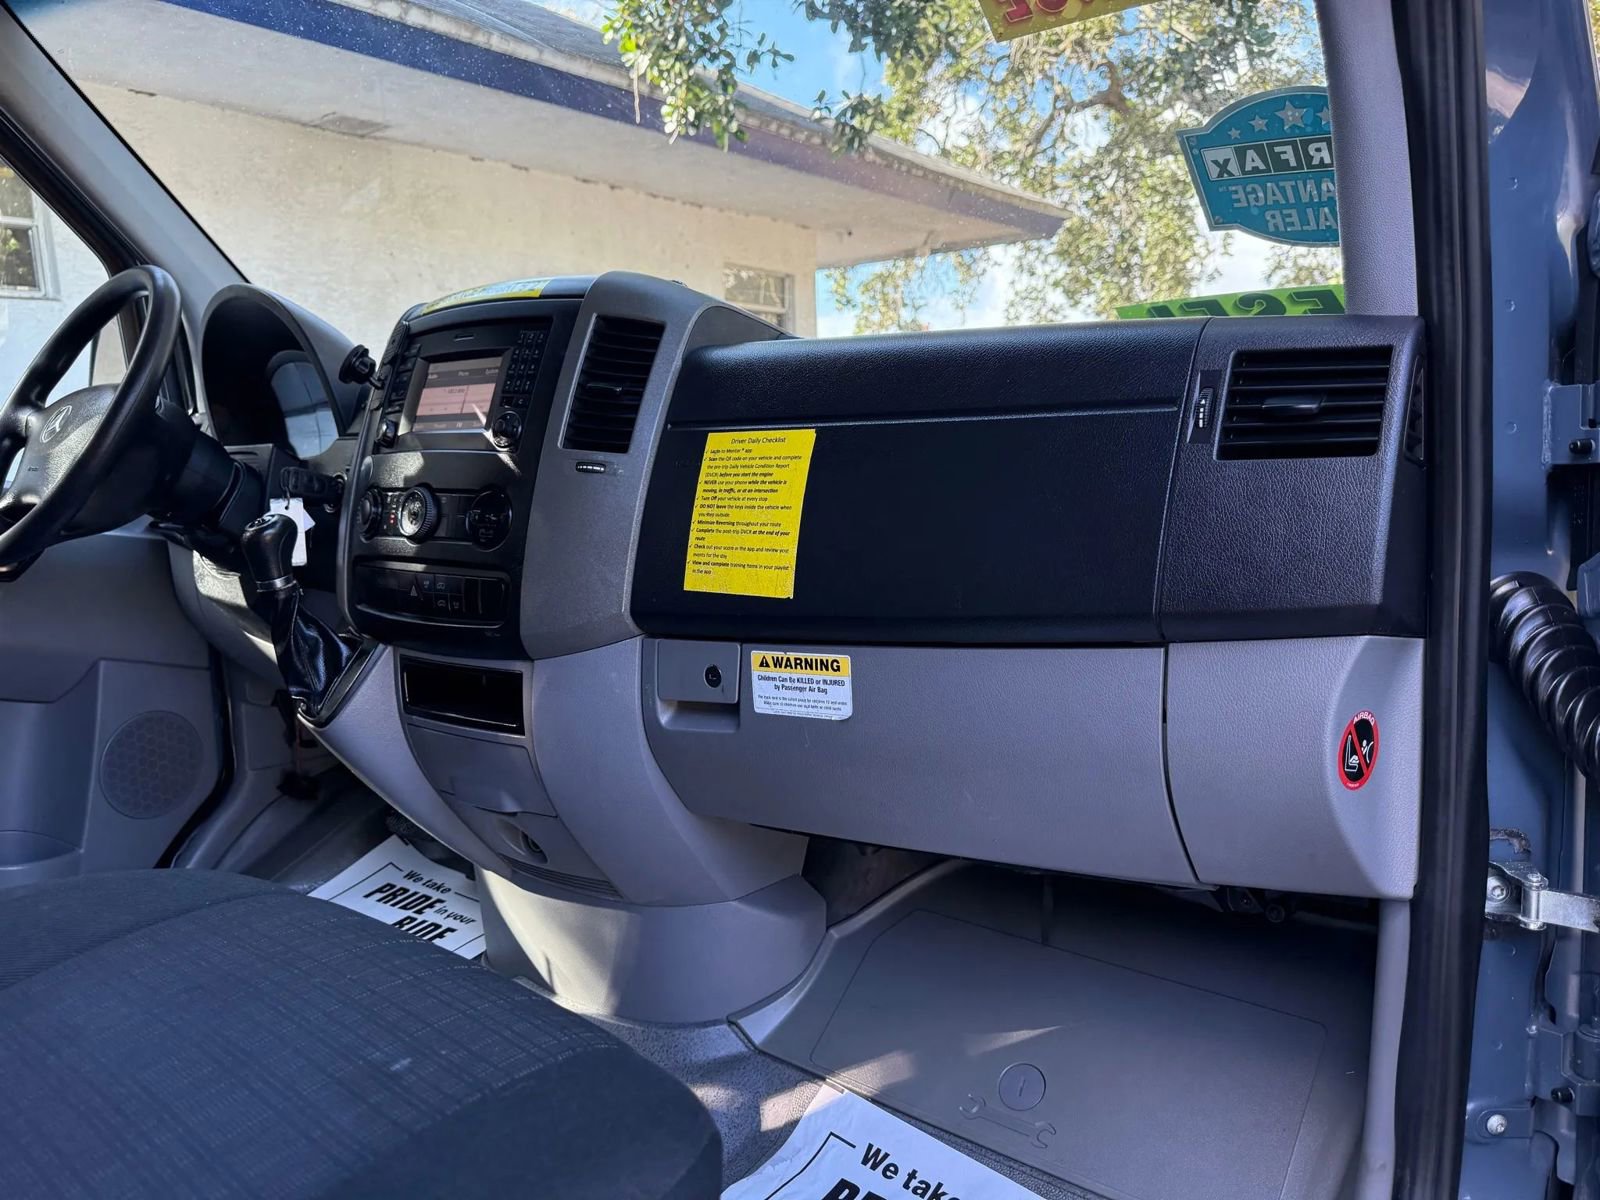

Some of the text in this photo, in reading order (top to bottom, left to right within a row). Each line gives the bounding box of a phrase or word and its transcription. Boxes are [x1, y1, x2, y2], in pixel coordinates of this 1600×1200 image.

[772, 656, 841, 672] WARNING
[781, 684, 807, 692] Passenger
[817, 687, 828, 695] Bag
[797, 677, 814, 685] KILLED
[403, 869, 452, 894] We take
[363, 882, 477, 926] PRIDE in your
[861, 1142, 899, 1180] We
[902, 1169, 960, 1200] tak
